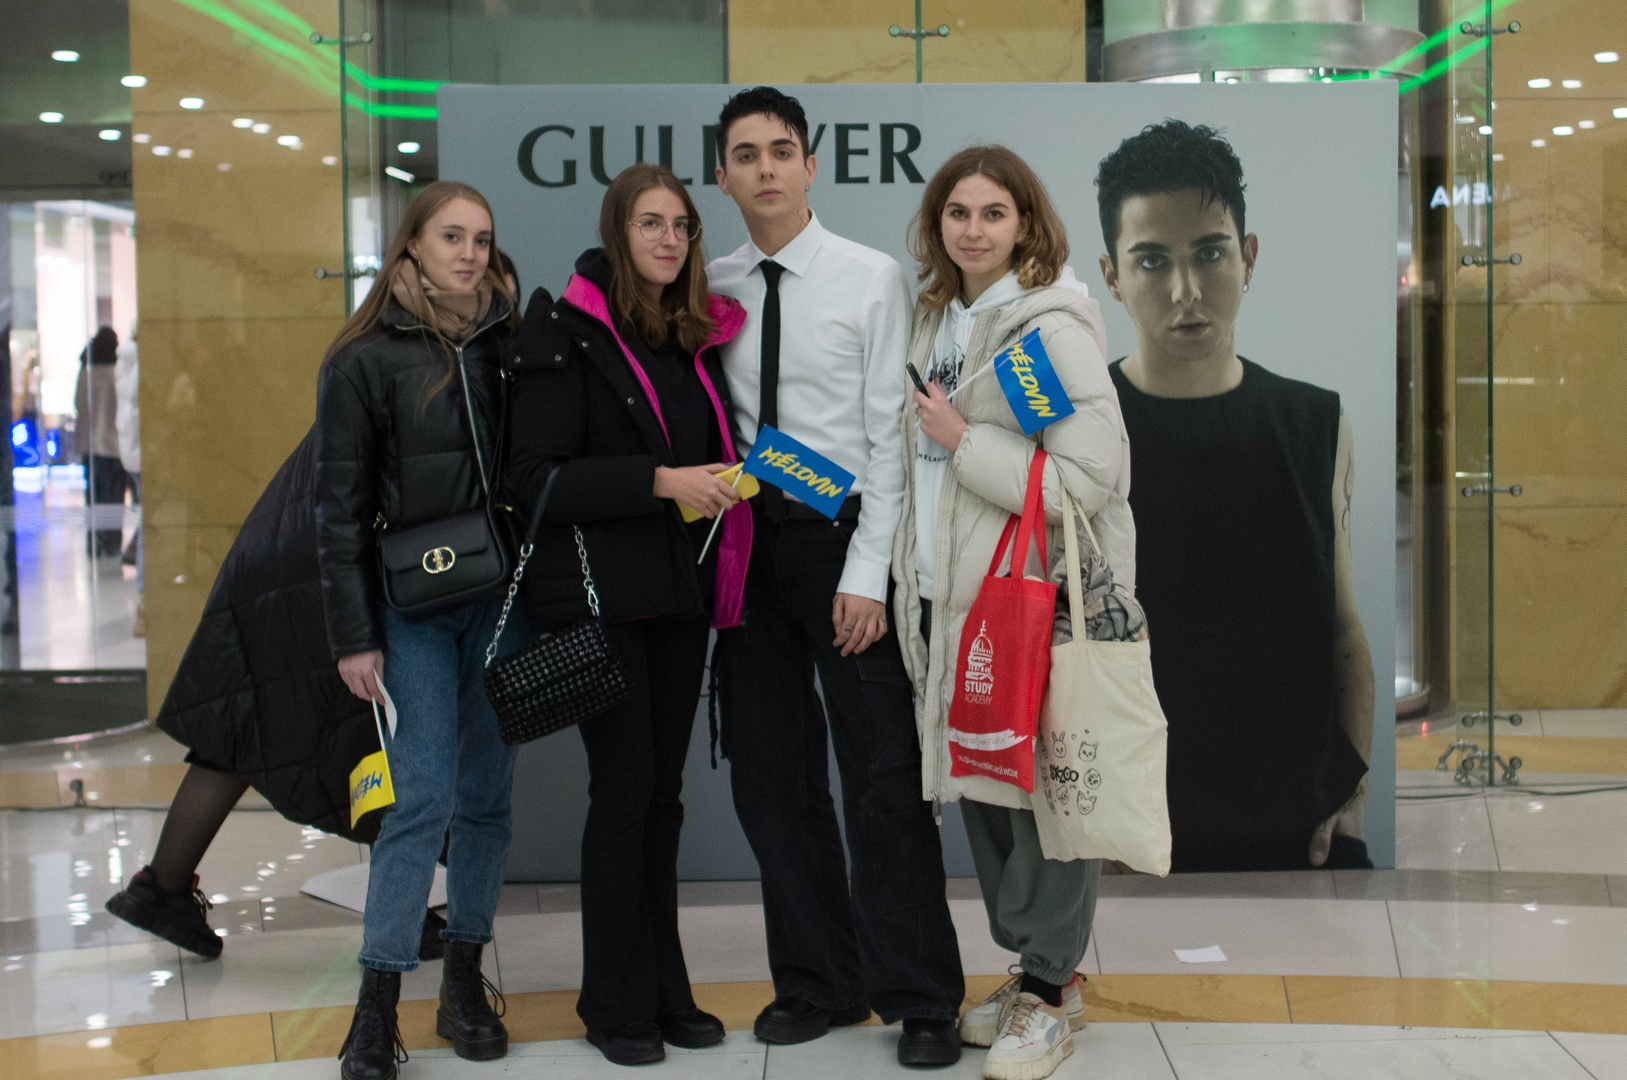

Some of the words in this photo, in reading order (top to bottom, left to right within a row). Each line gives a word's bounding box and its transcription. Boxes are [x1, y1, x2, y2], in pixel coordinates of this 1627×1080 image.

[964, 680, 993, 696] STUDY
[963, 692, 993, 706] ACADEMY
[1049, 764, 1079, 784] SKZOO
